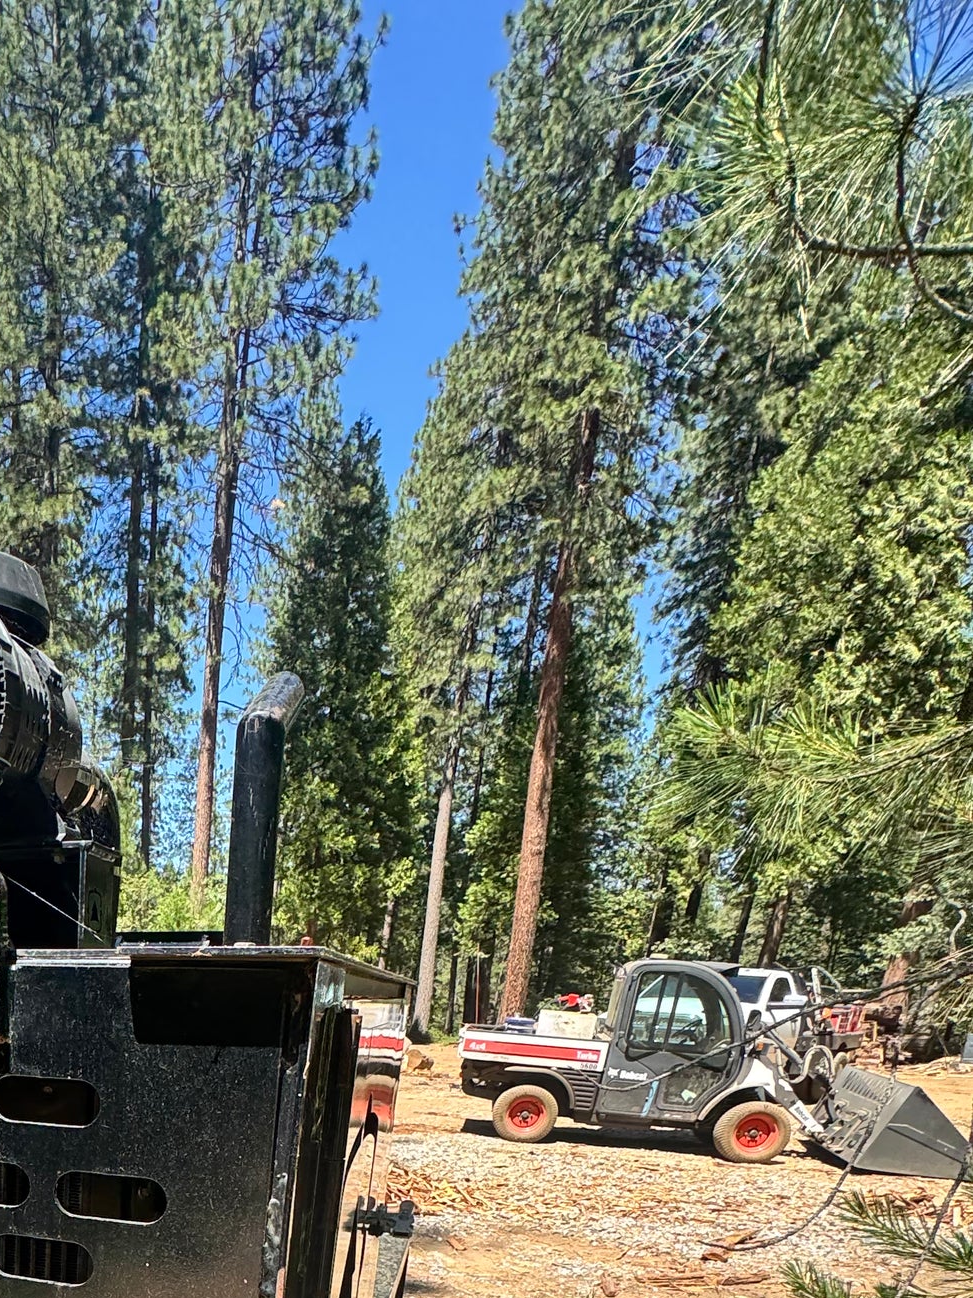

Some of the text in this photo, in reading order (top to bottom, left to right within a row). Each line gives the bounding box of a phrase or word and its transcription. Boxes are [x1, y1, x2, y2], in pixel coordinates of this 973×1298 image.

[576, 1051, 598, 1061] Turbo
[580, 1062, 598, 1070] 5600
[619, 1069, 648, 1080] Bobcat
